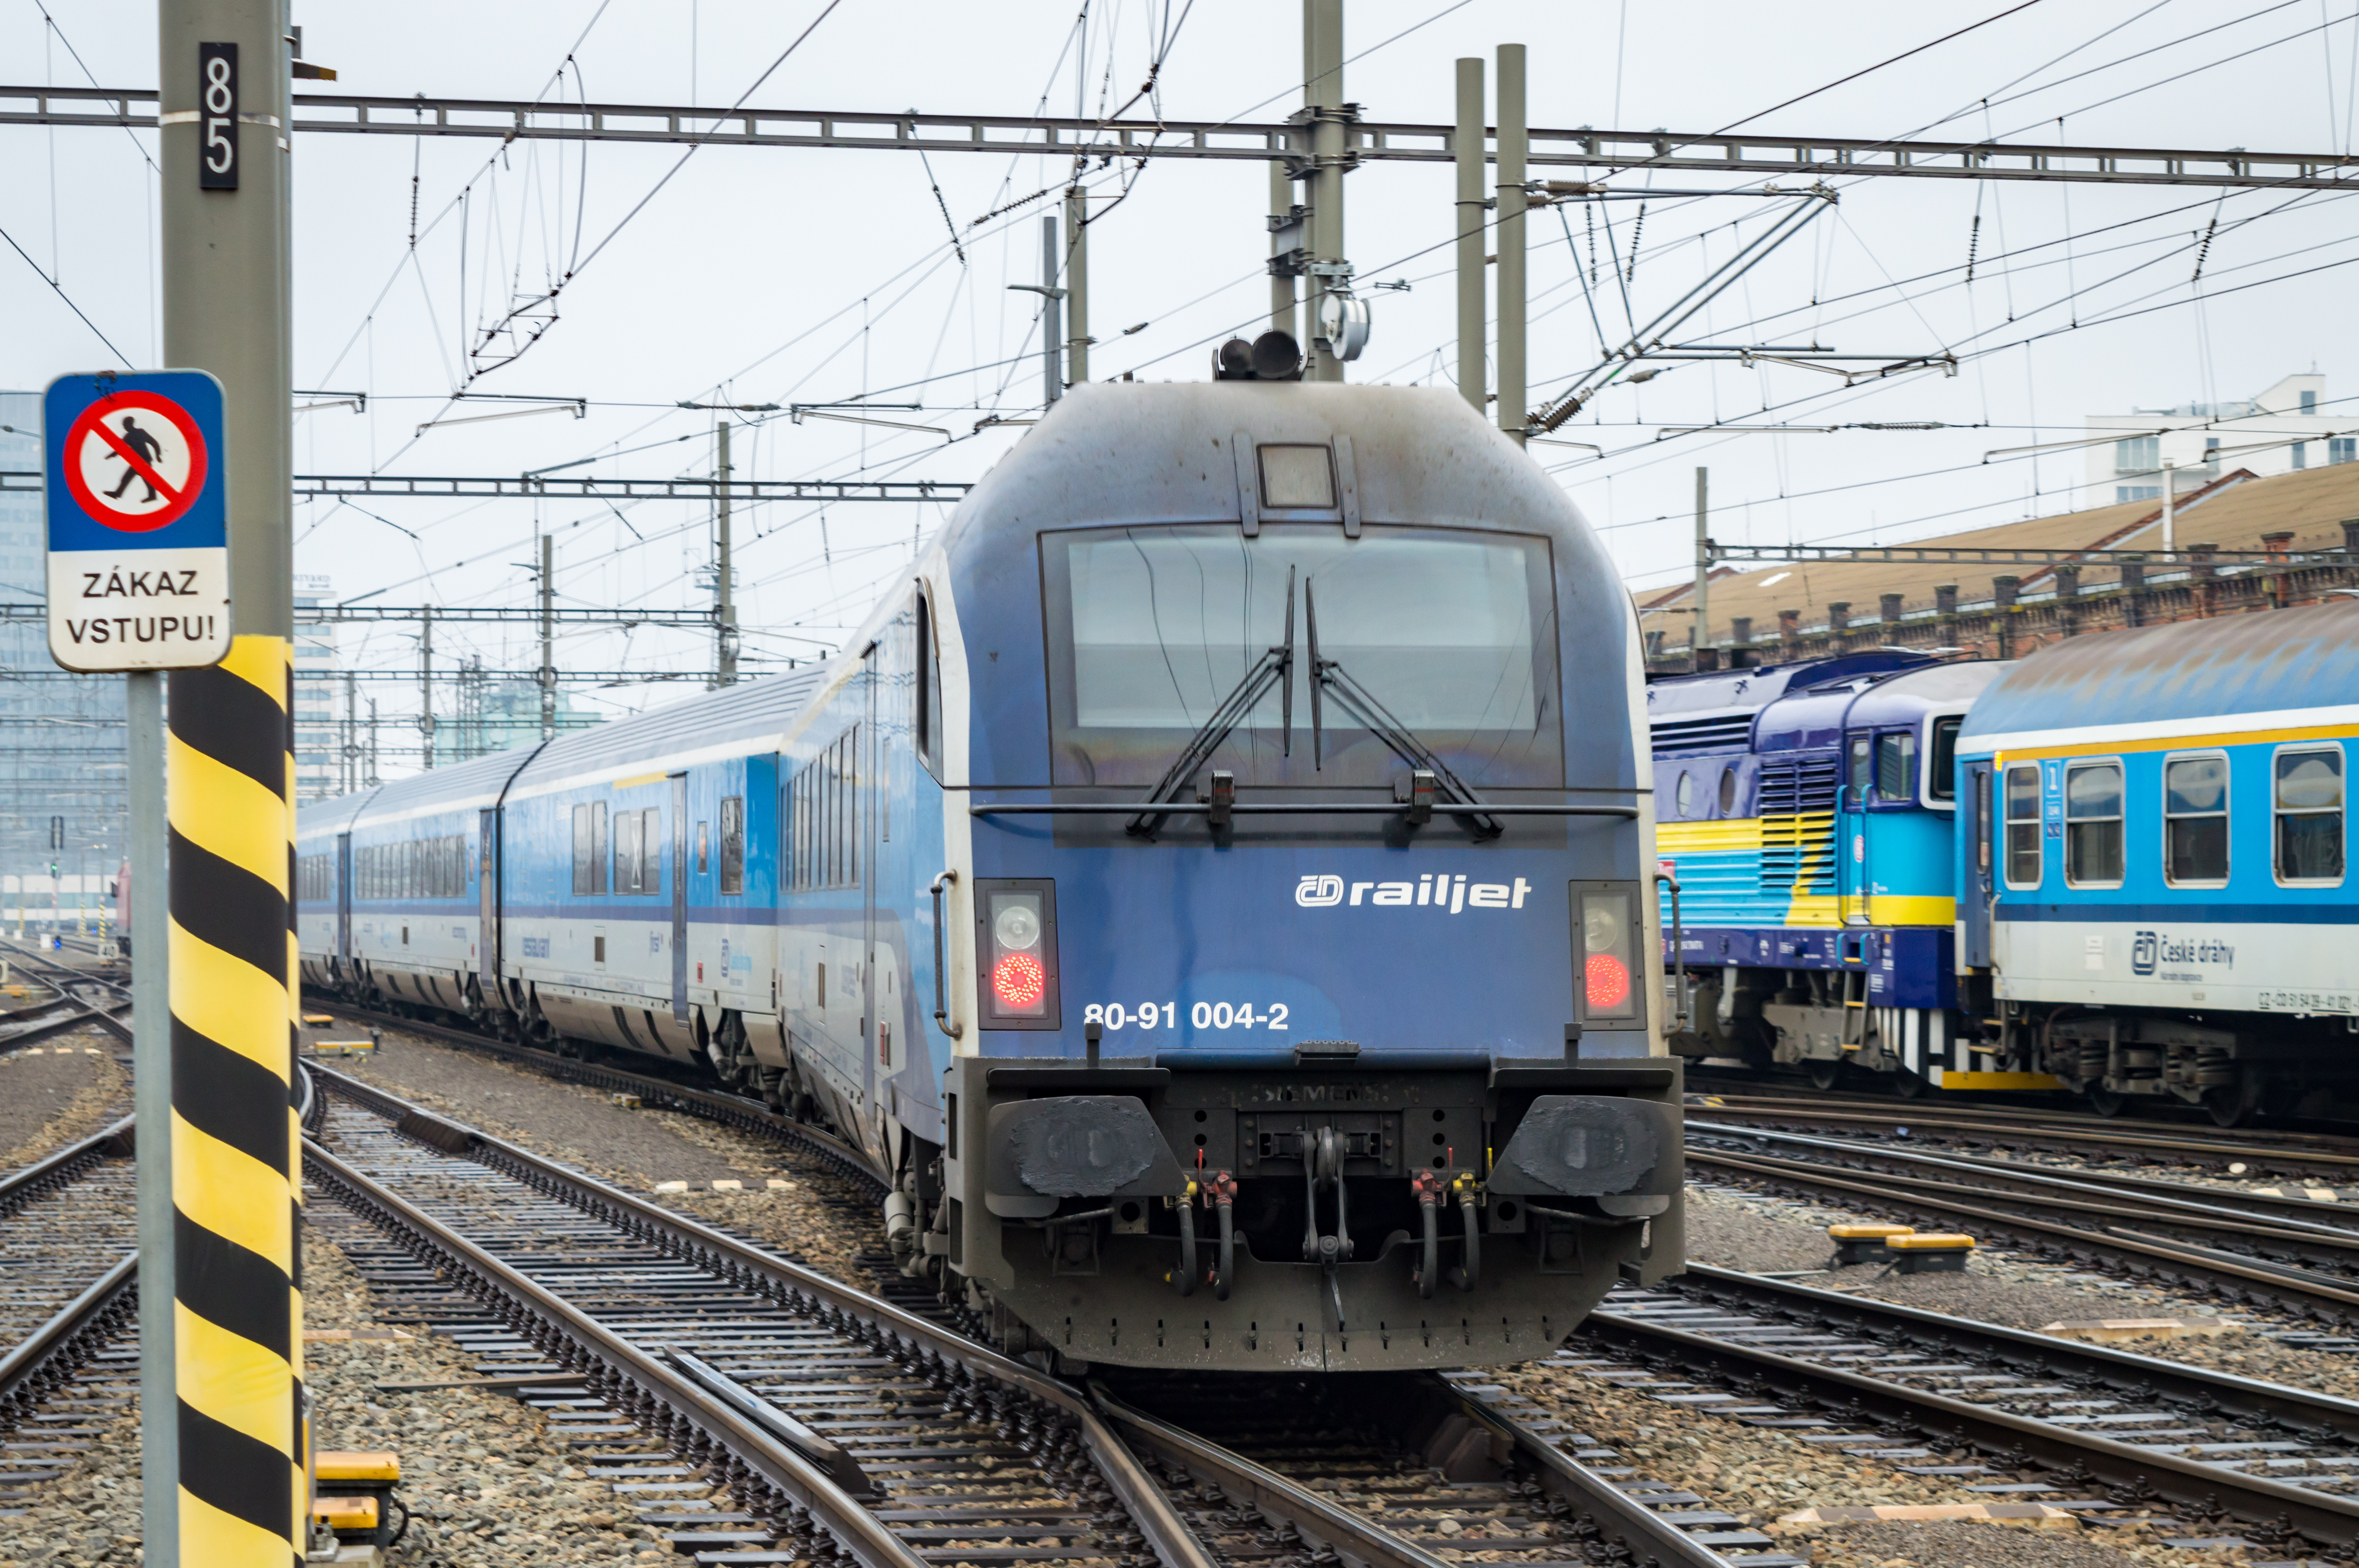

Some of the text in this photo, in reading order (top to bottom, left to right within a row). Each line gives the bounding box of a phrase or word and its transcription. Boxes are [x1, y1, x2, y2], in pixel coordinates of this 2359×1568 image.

[83, 565, 198, 597] ZÁKAZ
[67, 615, 214, 644] VSTUPU!
[1350, 874, 1532, 914] railjet
[2160, 934, 2195, 962] České
[2198, 939, 2235, 970] dráhy
[1084, 1002, 1289, 1030] 80-91 004-2
[1261, 1085, 1379, 1101] SIEMENS
